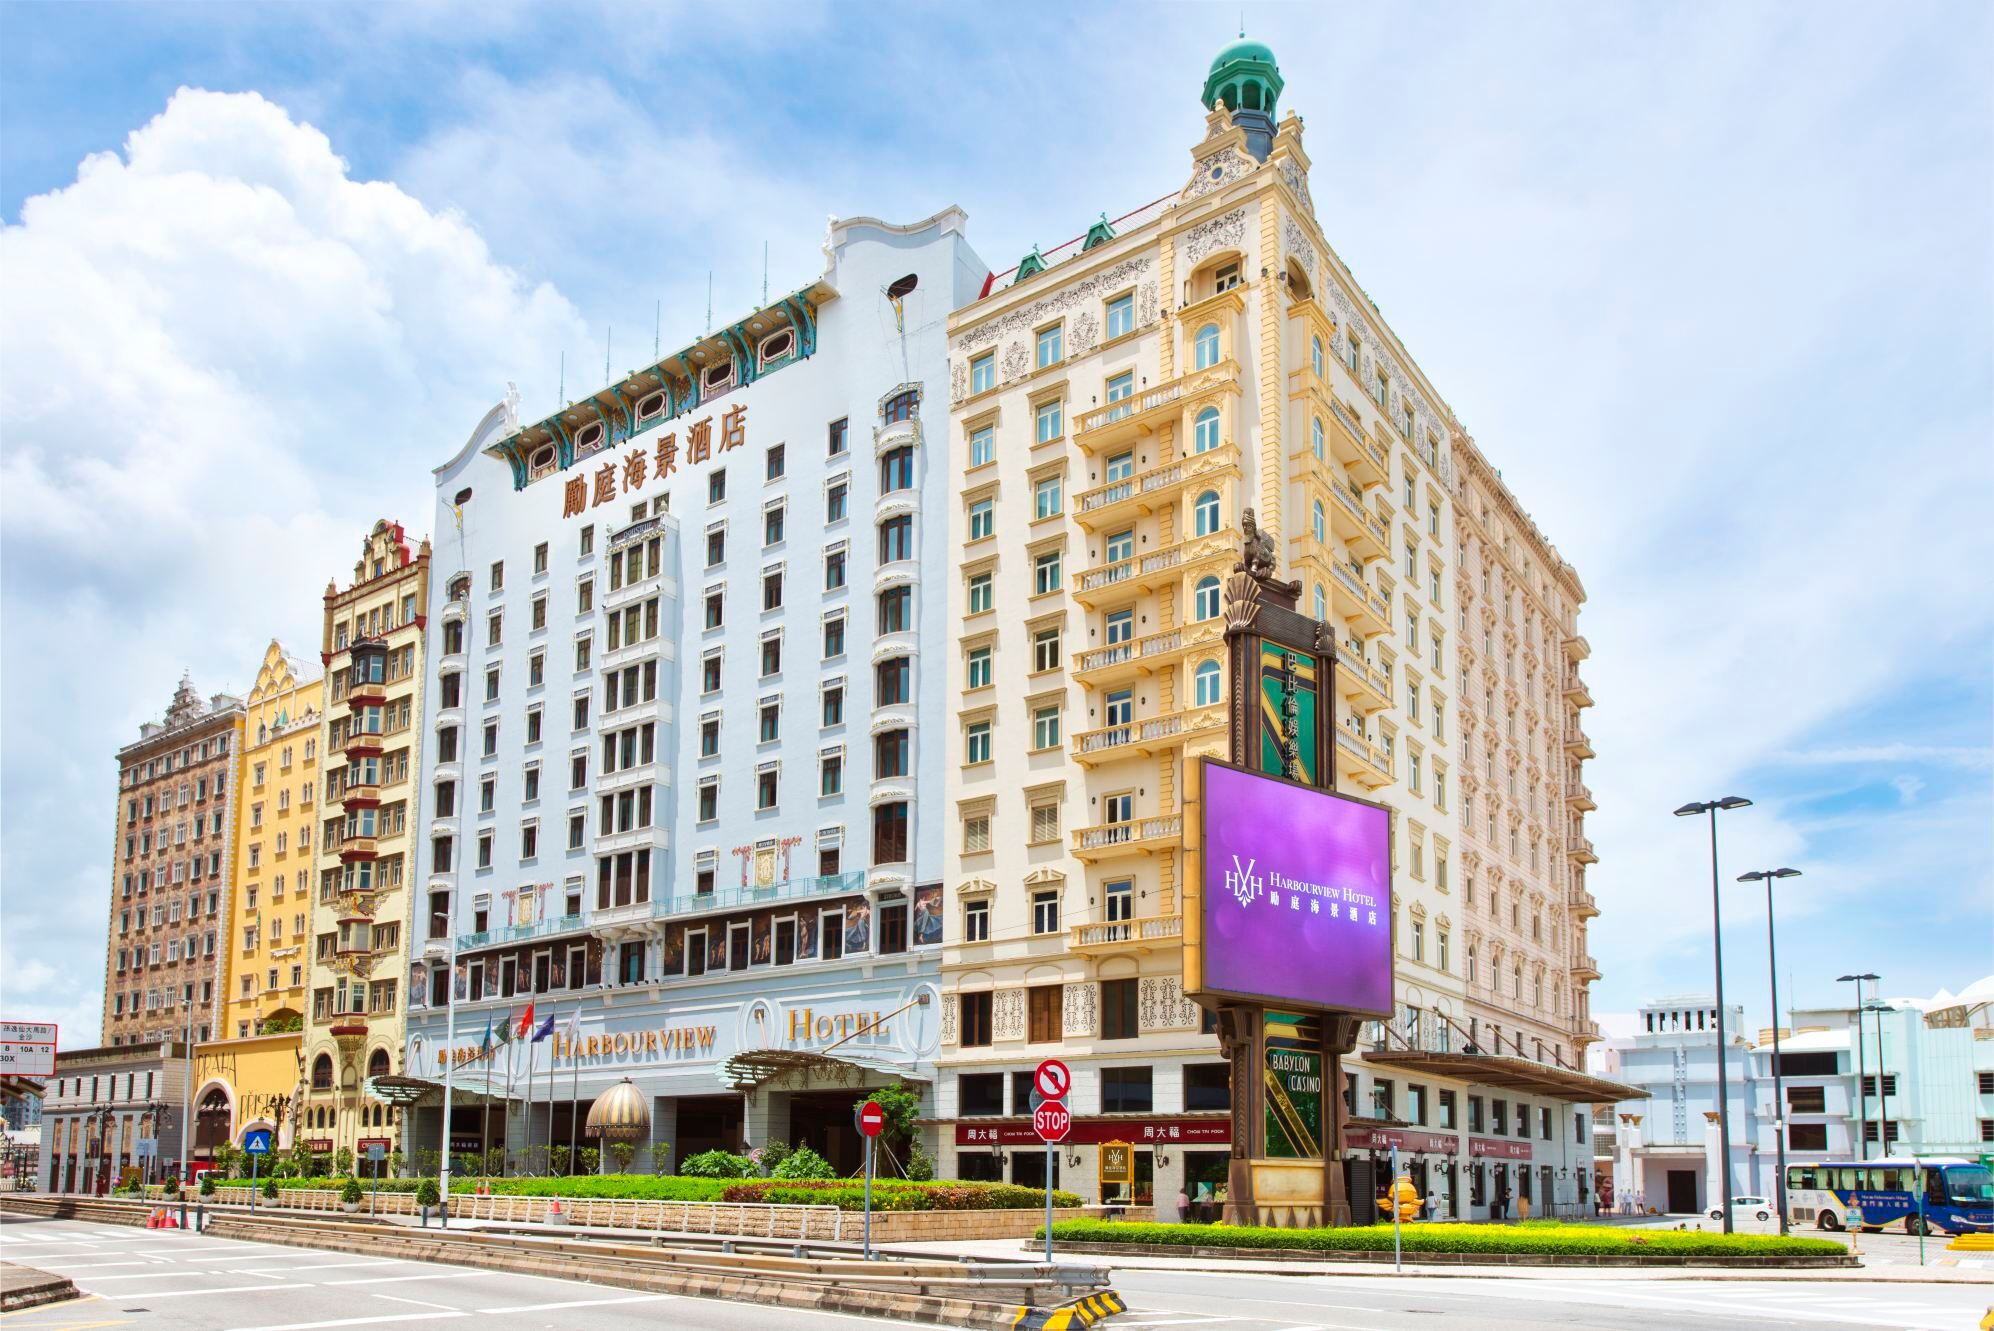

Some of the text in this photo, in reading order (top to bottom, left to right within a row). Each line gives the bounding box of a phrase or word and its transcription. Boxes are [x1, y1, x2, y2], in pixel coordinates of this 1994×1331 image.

[562, 403, 748, 519] 勵庭海景酒店
[195, 1050, 237, 1092] PRAHA
[1272, 1054, 1310, 1073] BABYLON
[1291, 1075, 1321, 1093] CASINO
[1037, 1111, 1068, 1130] STOP
[967, 1128, 998, 1140] 周大福
[1143, 1126, 1180, 1138] 周大福
